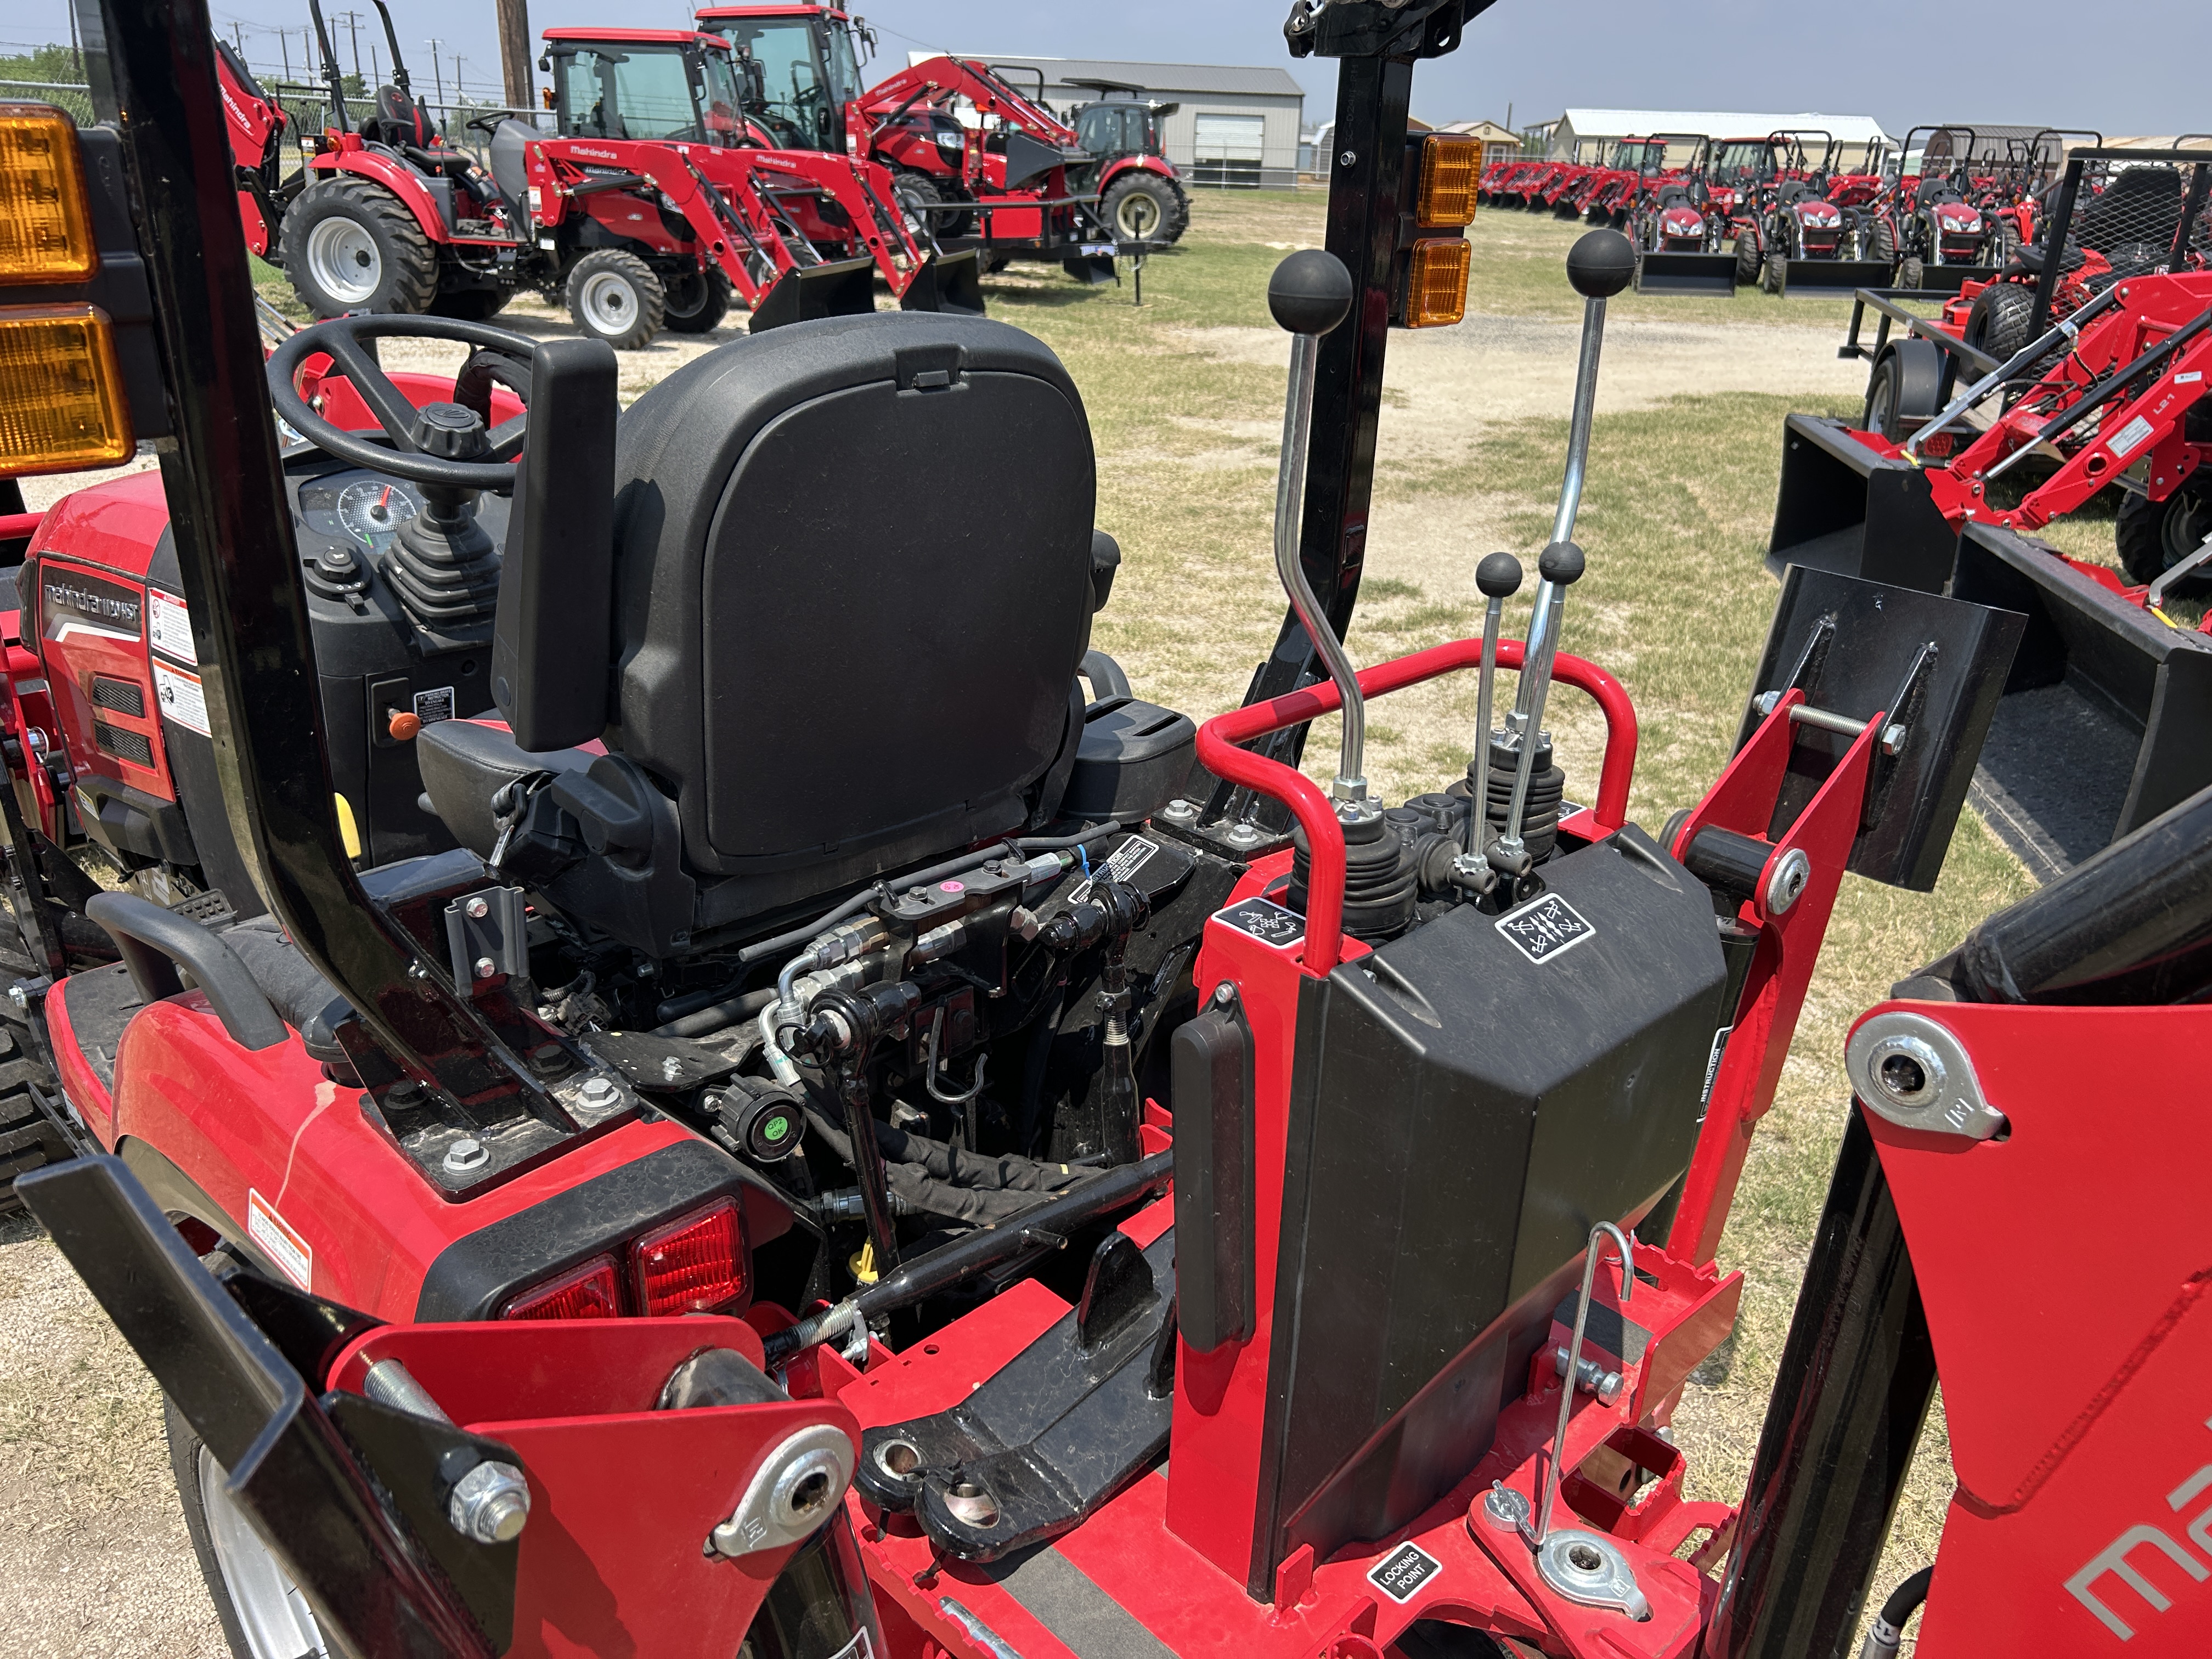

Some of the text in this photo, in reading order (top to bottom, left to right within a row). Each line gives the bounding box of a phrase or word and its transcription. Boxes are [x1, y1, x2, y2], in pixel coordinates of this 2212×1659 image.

[2153, 393, 2175, 415] L21
[1700, 1048, 1720, 1102] INSTRUCTION
[768, 1118, 783, 1130] QP2
[772, 1127, 783, 1137] OK
[1380, 1551, 1419, 1585] LOCKING
[1397, 1563, 1425, 1589] POINT
